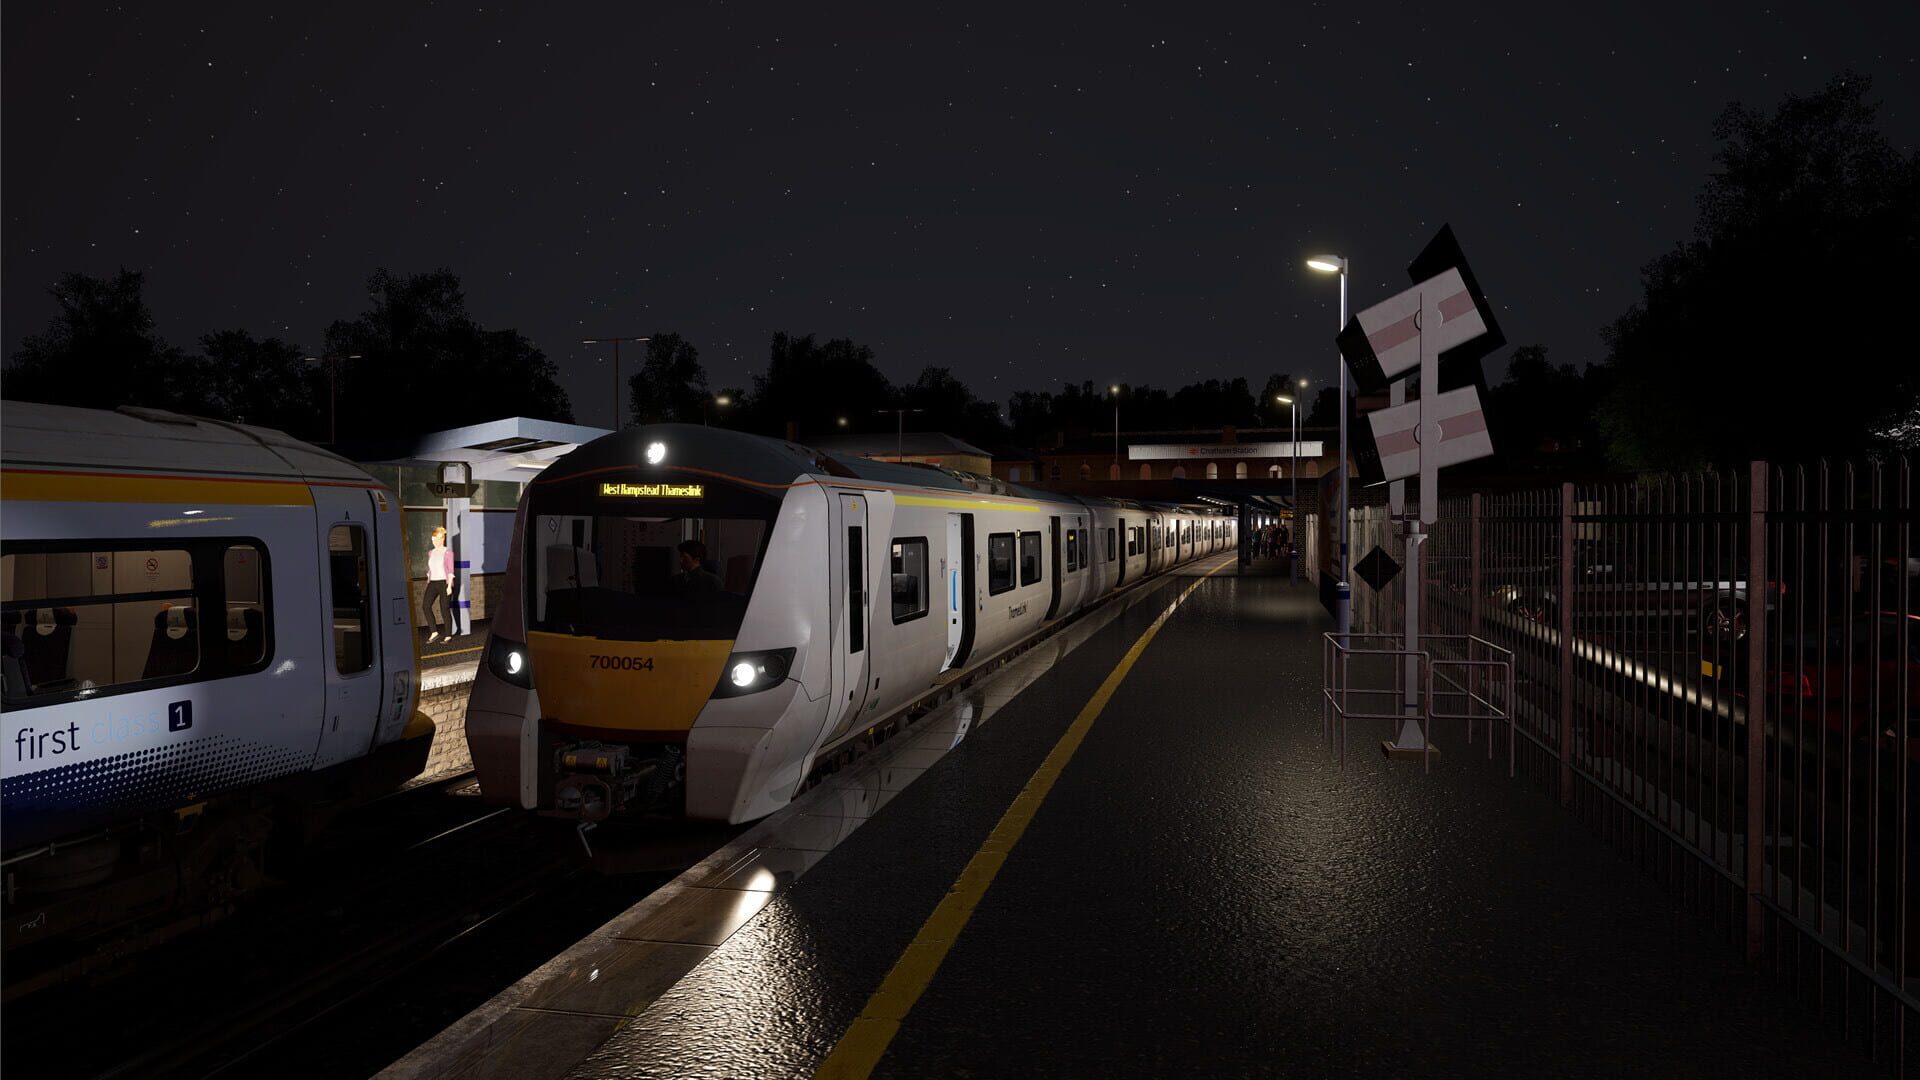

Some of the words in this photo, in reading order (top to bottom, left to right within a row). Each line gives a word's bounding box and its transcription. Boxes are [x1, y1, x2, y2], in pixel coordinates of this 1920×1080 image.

[1200, 447, 1232, 455] Chatham
[603, 483, 620, 495] West
[620, 483, 660, 498] Hampstead
[661, 484, 702, 497] Thameslink
[589, 655, 654, 671] 700054
[15, 721, 81, 762] first
[91, 711, 160, 743] class
